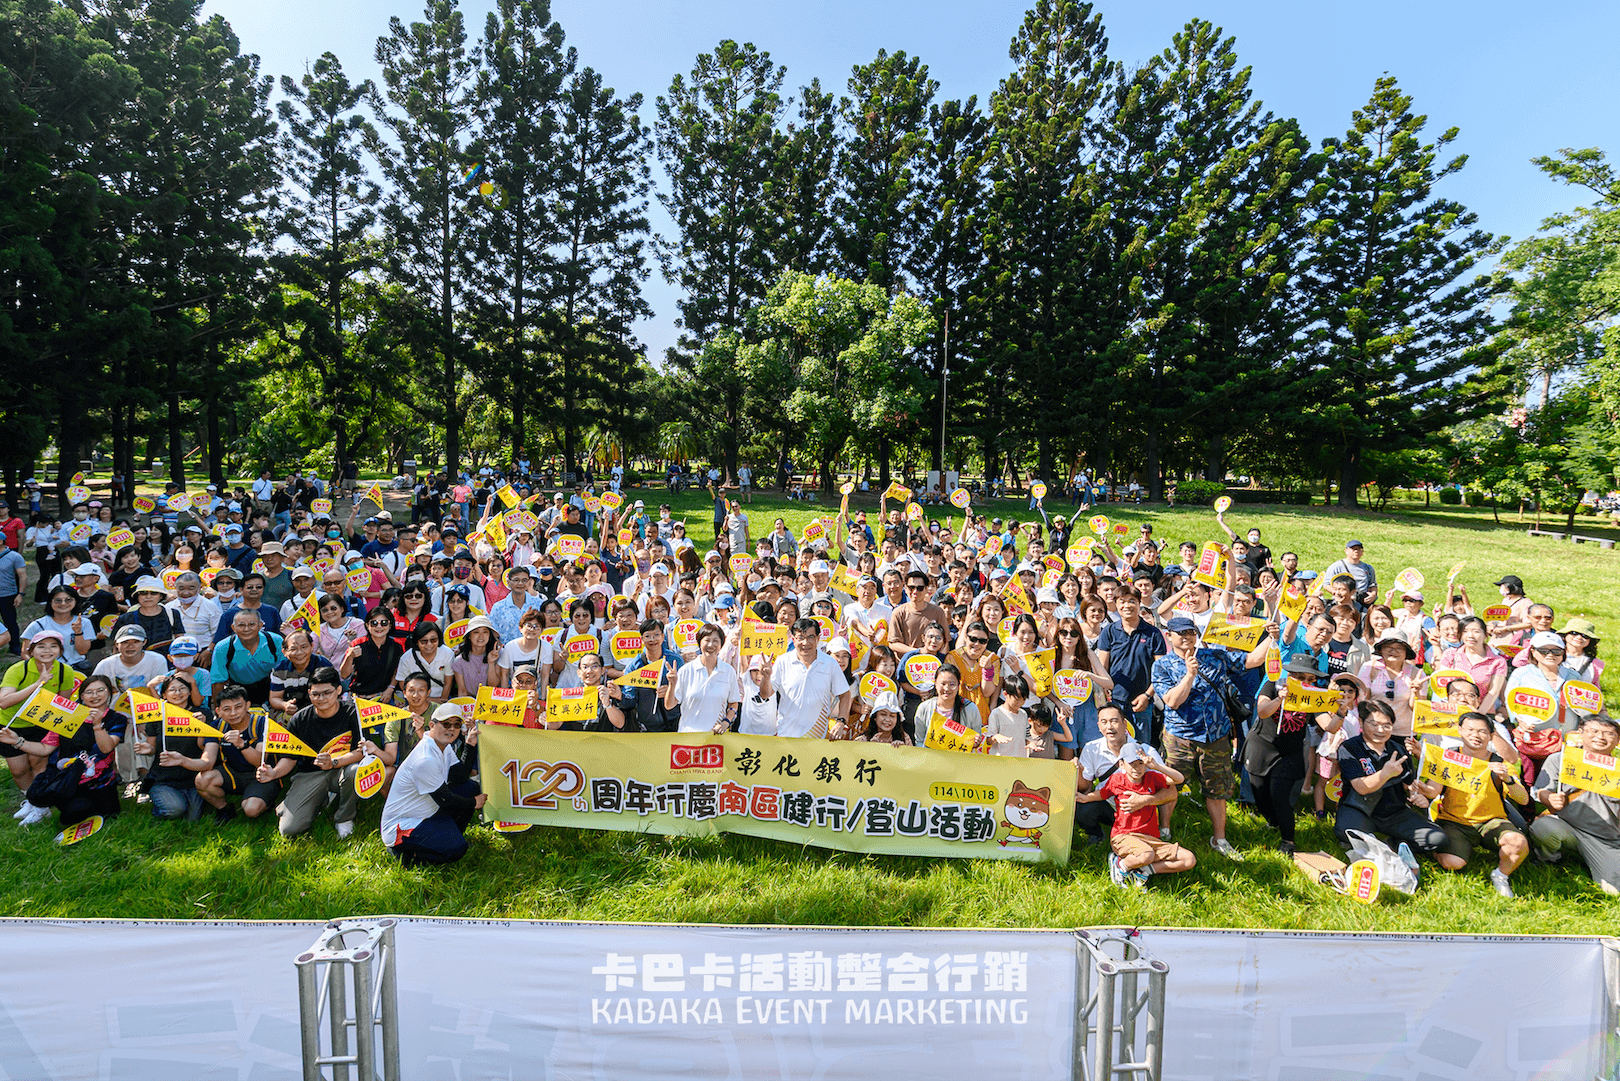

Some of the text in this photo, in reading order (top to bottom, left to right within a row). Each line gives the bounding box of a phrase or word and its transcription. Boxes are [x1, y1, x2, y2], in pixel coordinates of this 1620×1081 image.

[570, 640, 594, 653] CHB
[617, 638, 642, 649] CHB
[54, 696, 77, 710] CHB
[1515, 692, 1550, 710] CHB
[671, 746, 722, 769] CHB
[1445, 749, 1471, 765] CHB
[734, 747, 882, 787] 彰化銀行
[1358, 866, 1374, 899] CHB
